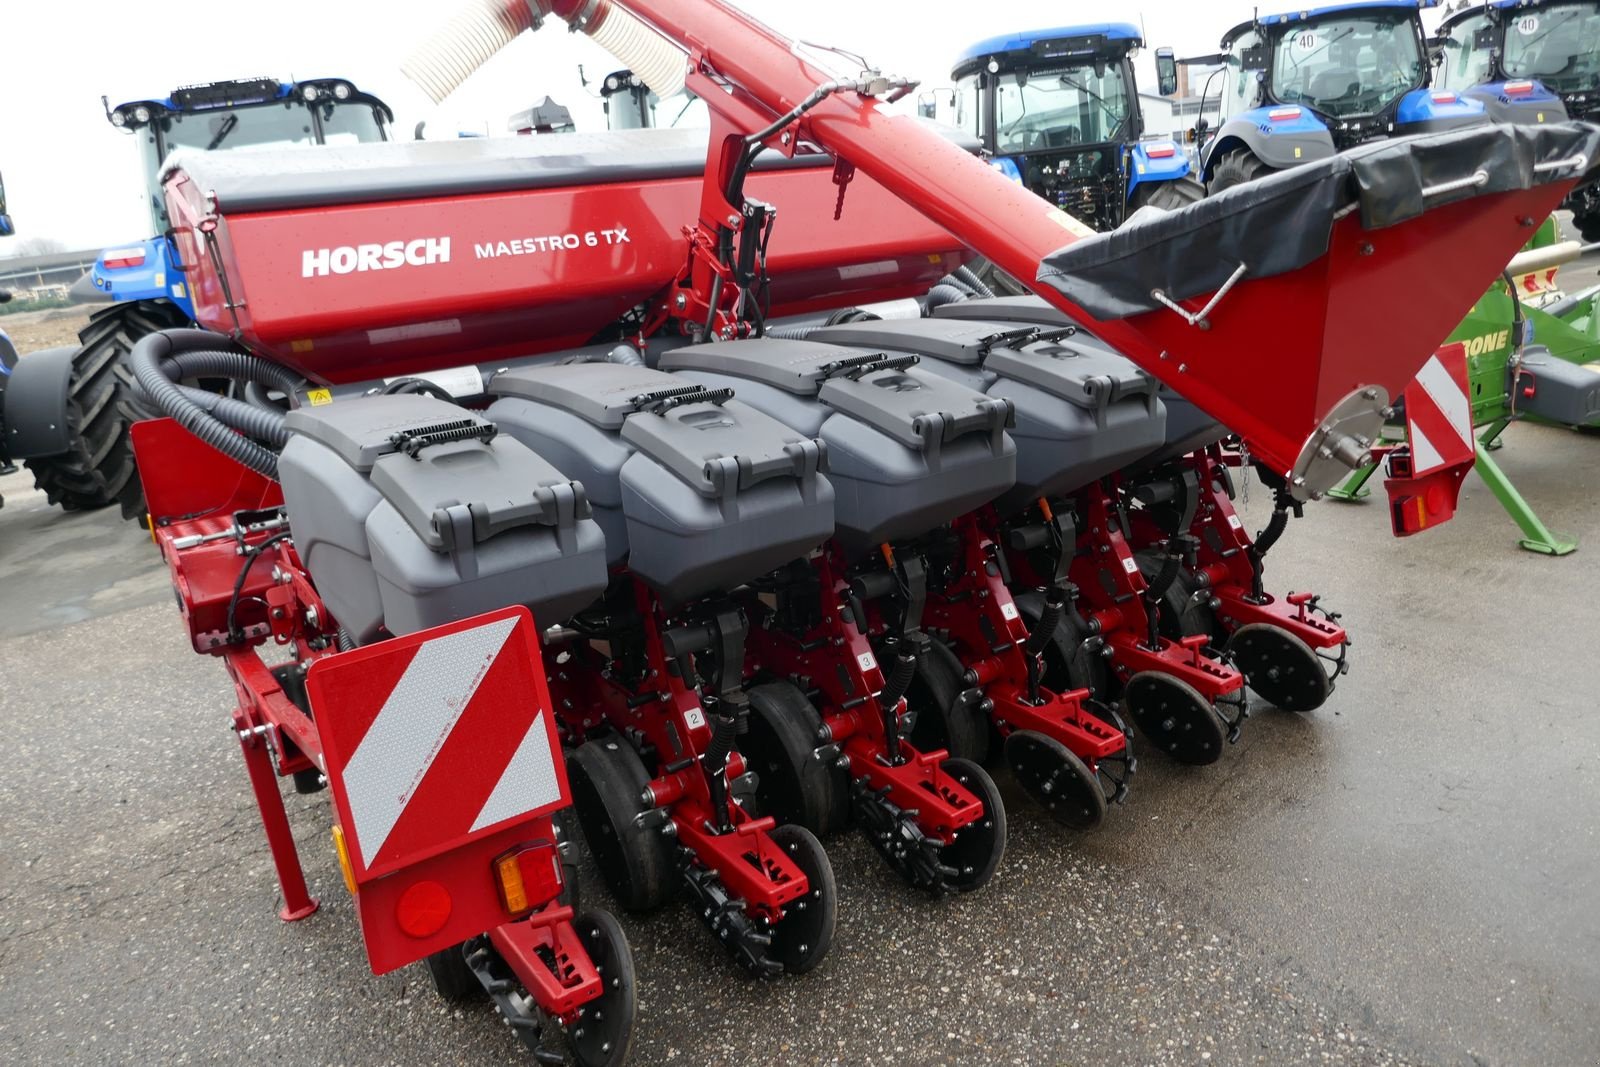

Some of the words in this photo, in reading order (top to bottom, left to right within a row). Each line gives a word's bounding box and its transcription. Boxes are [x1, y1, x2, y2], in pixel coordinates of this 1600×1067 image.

[1521, 19, 1535, 31] 40
[1299, 35, 1314, 48] 40
[474, 233, 580, 259] MAESTRO
[584, 231, 598, 247] 6
[601, 228, 630, 245] TX
[302, 237, 451, 278] HORSCH
[862, 656, 871, 667] 3
[690, 713, 700, 725] 2
